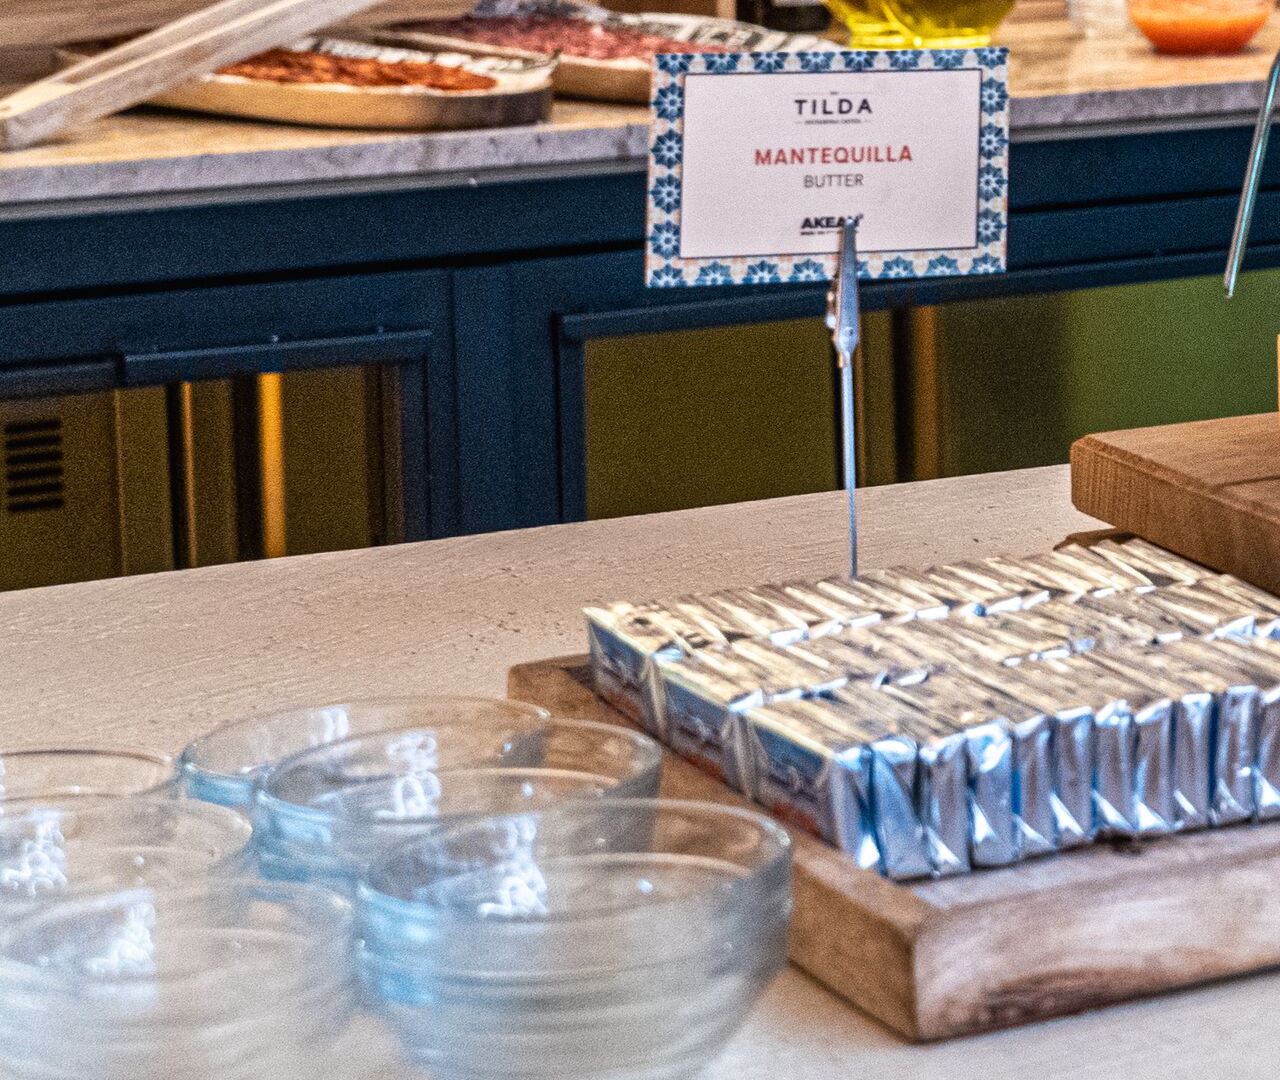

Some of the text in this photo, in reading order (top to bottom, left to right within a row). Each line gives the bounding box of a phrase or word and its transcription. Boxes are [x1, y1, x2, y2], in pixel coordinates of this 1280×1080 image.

[794, 98, 873, 115] TILDA
[754, 145, 914, 166] MANTEQUILLA
[803, 173, 865, 189] BUTTER
